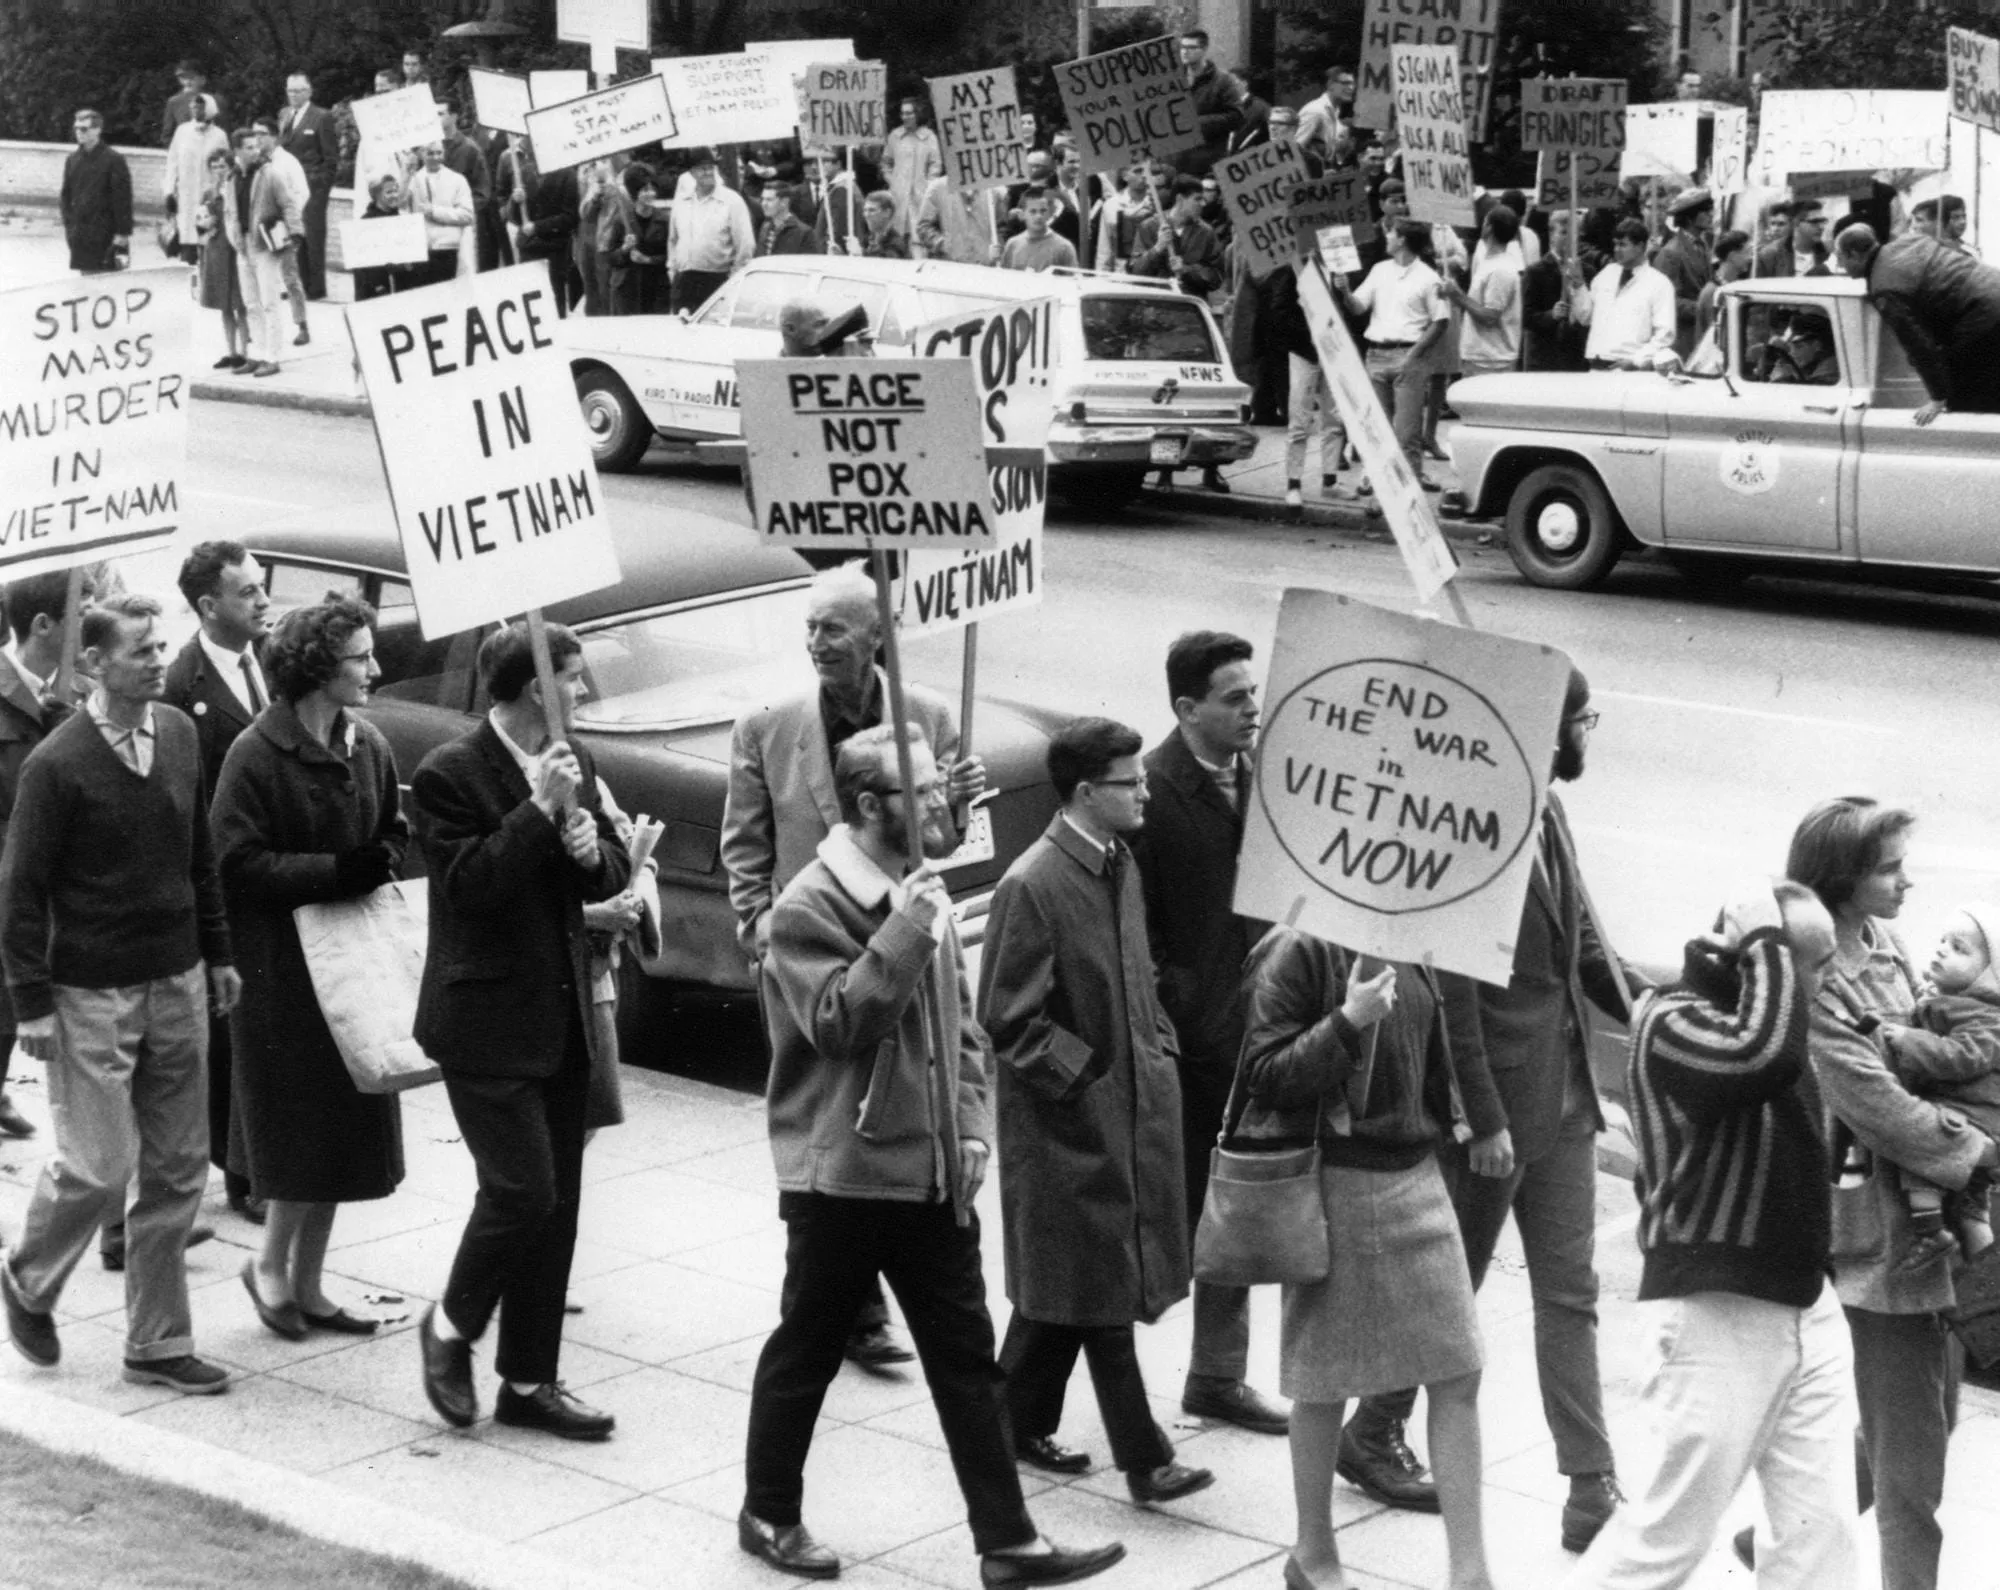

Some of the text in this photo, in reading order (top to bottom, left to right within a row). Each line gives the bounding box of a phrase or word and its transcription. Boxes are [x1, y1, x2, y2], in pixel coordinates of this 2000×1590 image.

[1068, 36, 1180, 95] SUPPORT
[1460, 30, 1496, 66] IT
[1950, 32, 1984, 63] BUY
[685, 67, 765, 88] SUPPORT
[819, 68, 884, 91] DRAFT
[1397, 54, 1457, 86] SIGMA
[950, 76, 995, 111] MY
[1074, 78, 1189, 117] YOUR LOCAL
[1398, 90, 1424, 117] CHI
[1427, 90, 1462, 124] SAYS
[1541, 83, 1626, 103] DRAFT
[575, 113, 618, 134] STAY
[941, 104, 1017, 145] FEET
[1085, 97, 1193, 155] POLICE
[1404, 125, 1437, 152] USA
[1441, 129, 1468, 158] ALL
[1525, 109, 1626, 148] FRINGIES
[955, 142, 1025, 185] HURT
[1226, 139, 1295, 183] BITCH
[1408, 159, 1469, 198] THE WAY
[1291, 178, 1356, 206] DRAFT
[1250, 215, 1297, 252] BITC
[34, 287, 152, 341] STOP
[381, 290, 553, 384] PEACE
[42, 334, 153, 382] MASS
[1179, 366, 1223, 382] NEWS
[0, 374, 182, 441] MURDER
[787, 373, 926, 408] PEACE
[473, 384, 532, 458] IN
[821, 418, 902, 452] NOT
[52, 448, 101, 487] IN
[828, 462, 912, 497] POX
[418, 469, 596, 564] VIETNAM
[767, 501, 990, 535] AMERICANA
[914, 538, 1033, 624] VIETNAM
[1363, 676, 1449, 719] END
[1304, 697, 1499, 767] THE WAR
[1377, 747, 1405, 778] in
[1285, 757, 1500, 851] VIETNAM
[1319, 826, 1453, 891] NOW
